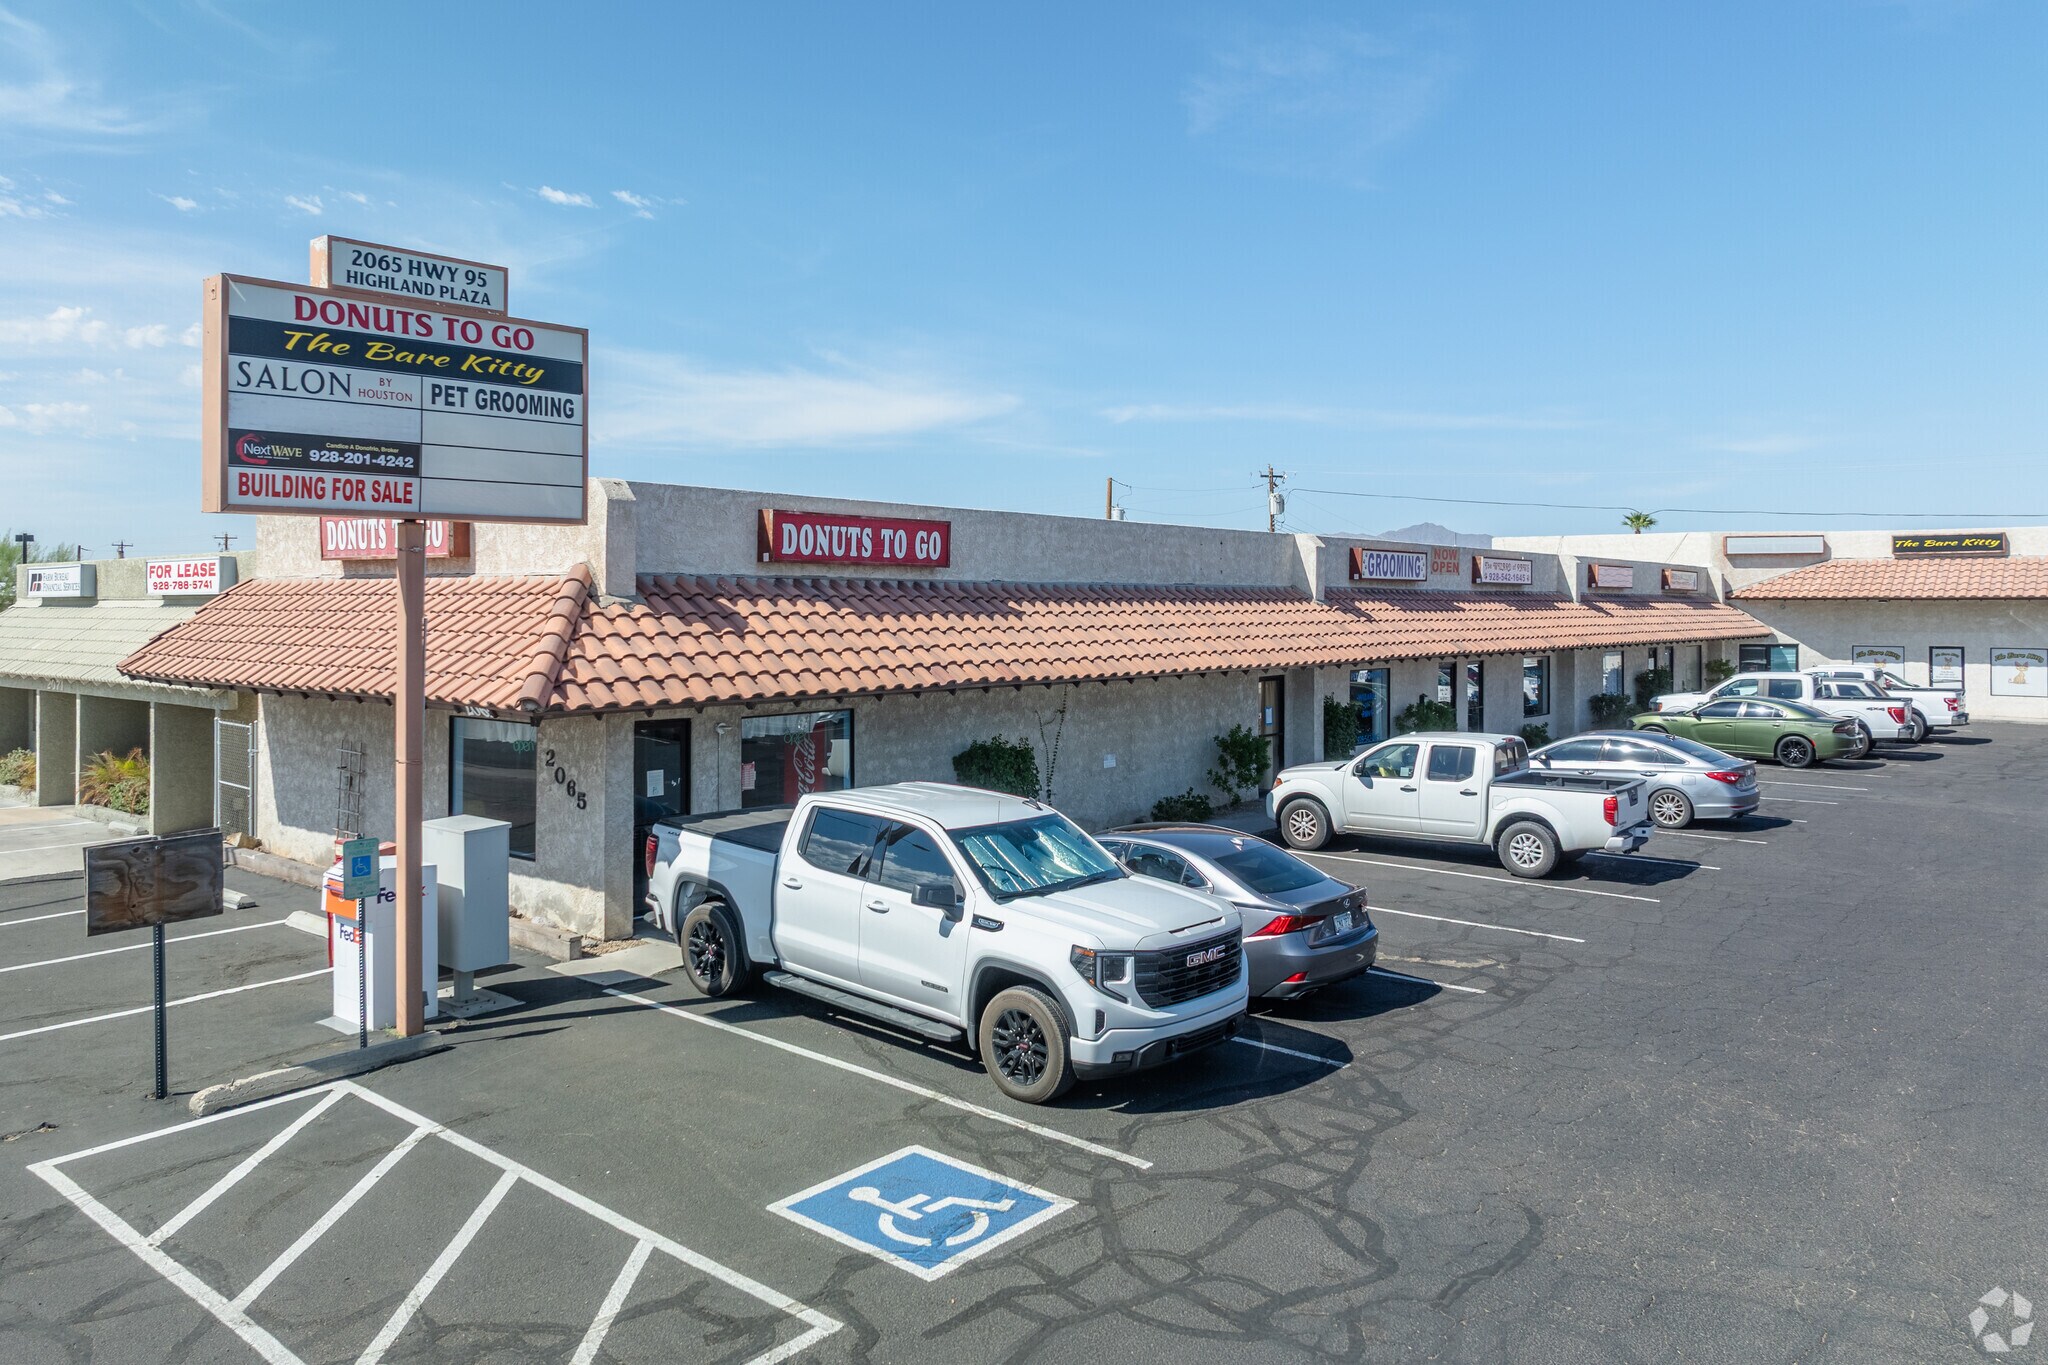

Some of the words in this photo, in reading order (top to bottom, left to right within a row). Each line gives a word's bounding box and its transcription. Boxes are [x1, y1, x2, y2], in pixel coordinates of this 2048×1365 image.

[351, 249, 403, 273] 2065
[408, 259, 458, 283] HWY
[464, 268, 488, 288] 95
[346, 269, 435, 297] HIGHLAND
[439, 285, 491, 306] PLAZA
[294, 295, 433, 338] DONUTS
[442, 316, 483, 345] TO
[491, 325, 535, 351] GO
[283, 329, 350, 356] The
[364, 340, 451, 368] Bare
[460, 353, 545, 385] Kitty
[236, 360, 352, 399] SALON
[379, 376, 392, 388] BY
[358, 387, 413, 403] HOUSTON
[430, 383, 469, 409] PET
[475, 388, 575, 420] GROOMING
[309, 449, 415, 468] 928-201-4242
[325, 442, 349, 450] Candice
[238, 471, 326, 501] BUILDING
[332, 477, 366, 502] FOR
[371, 480, 413, 505] SALE
[325, 518, 387, 551] DONUTS
[781, 523, 873, 558] DONUTS
[881, 528, 907, 560] TO
[915, 529, 941, 560] GO
[1895, 539, 1920, 548] The
[1923, 539, 1959, 548] Bare
[1962, 538, 2001, 548] Kitty
[1368, 552, 1421, 578] GROOMING
[1434, 548, 1457, 560] NOW
[149, 564, 172, 580] FOR
[176, 562, 217, 578] LEASE
[1431, 561, 1460, 573] OPEN
[152, 579, 213, 591] 928-788-5741
[1186, 944, 1226, 968] GMC
